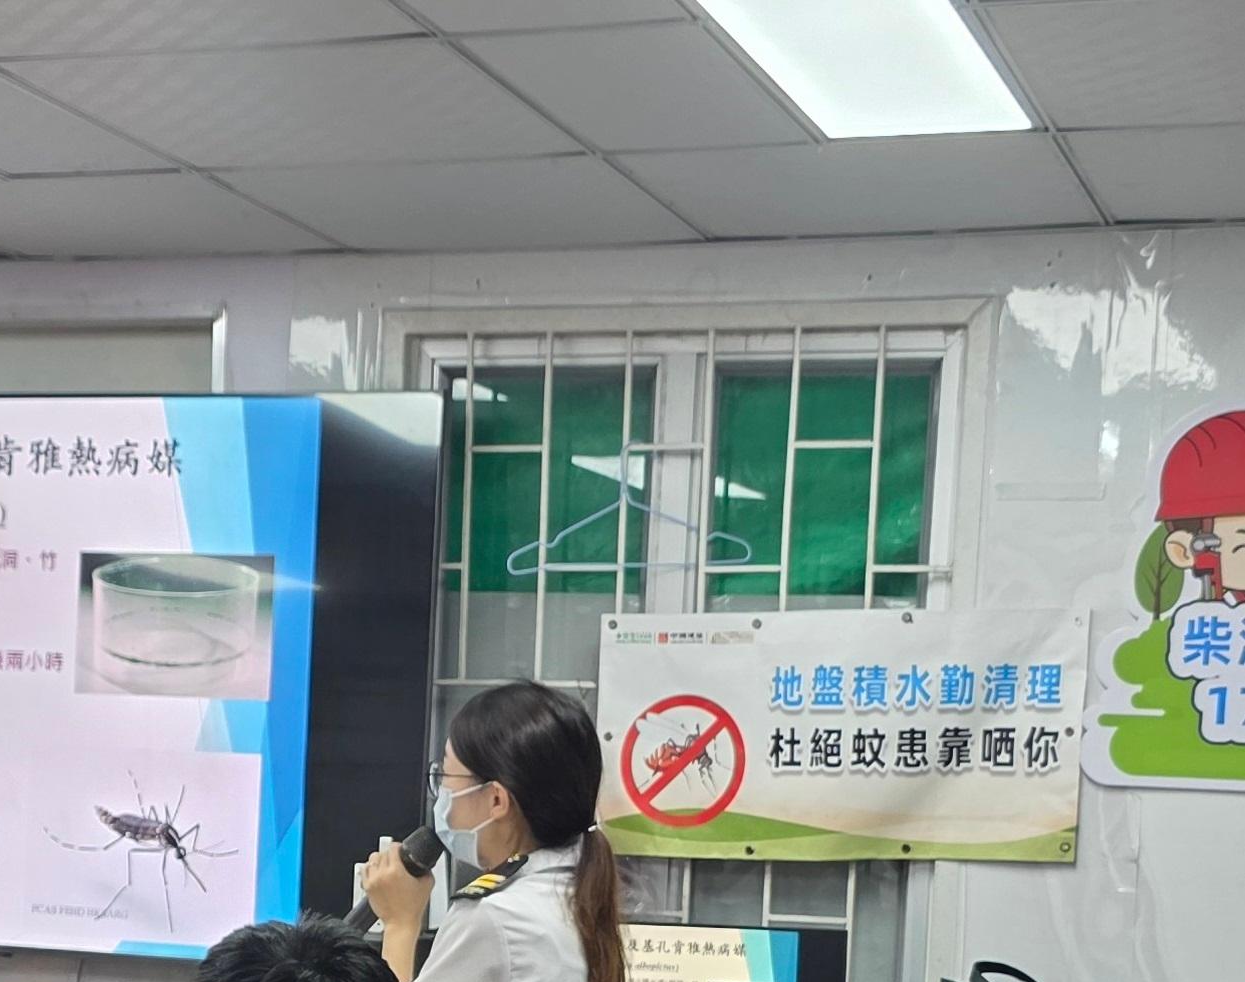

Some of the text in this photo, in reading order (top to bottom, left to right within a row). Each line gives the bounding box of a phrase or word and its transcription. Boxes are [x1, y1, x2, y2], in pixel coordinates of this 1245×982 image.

[1182, 616, 1245, 667] 柴
[770, 663, 1062, 707] 地盤積水勤清理
[1208, 686, 1245, 725] 1
